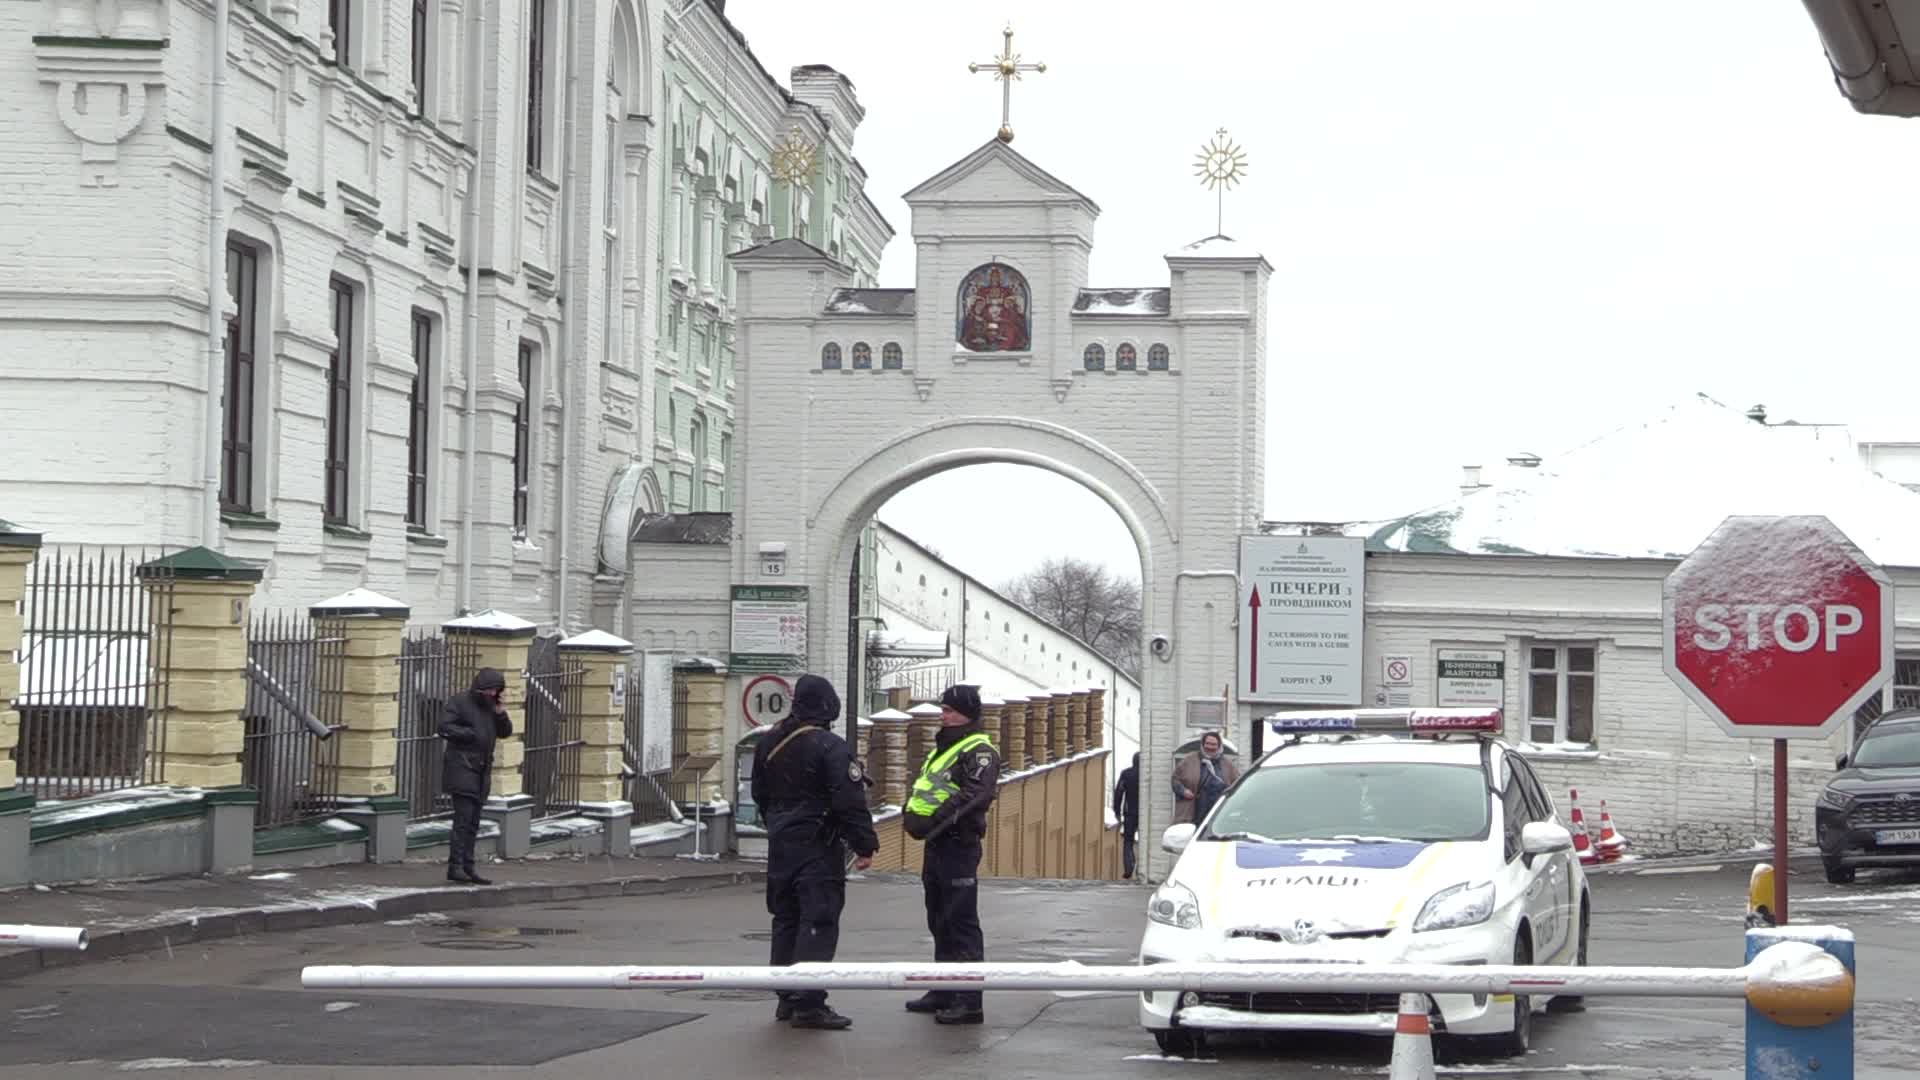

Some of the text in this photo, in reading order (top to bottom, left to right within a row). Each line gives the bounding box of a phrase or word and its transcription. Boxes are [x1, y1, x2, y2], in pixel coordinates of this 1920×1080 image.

[767, 564, 780, 574] 15
[1269, 581, 1341, 595] ПЕЧЕРИ
[1269, 598, 1352, 609] ПРОВІДНИКОМ
[1693, 603, 1864, 652] STOP
[1268, 631, 1349, 640] EXCURSIONS TO THE
[1324, 641, 1350, 649] GUIDE
[1318, 674, 1333, 686] 39
[755, 692, 784, 714] 10
